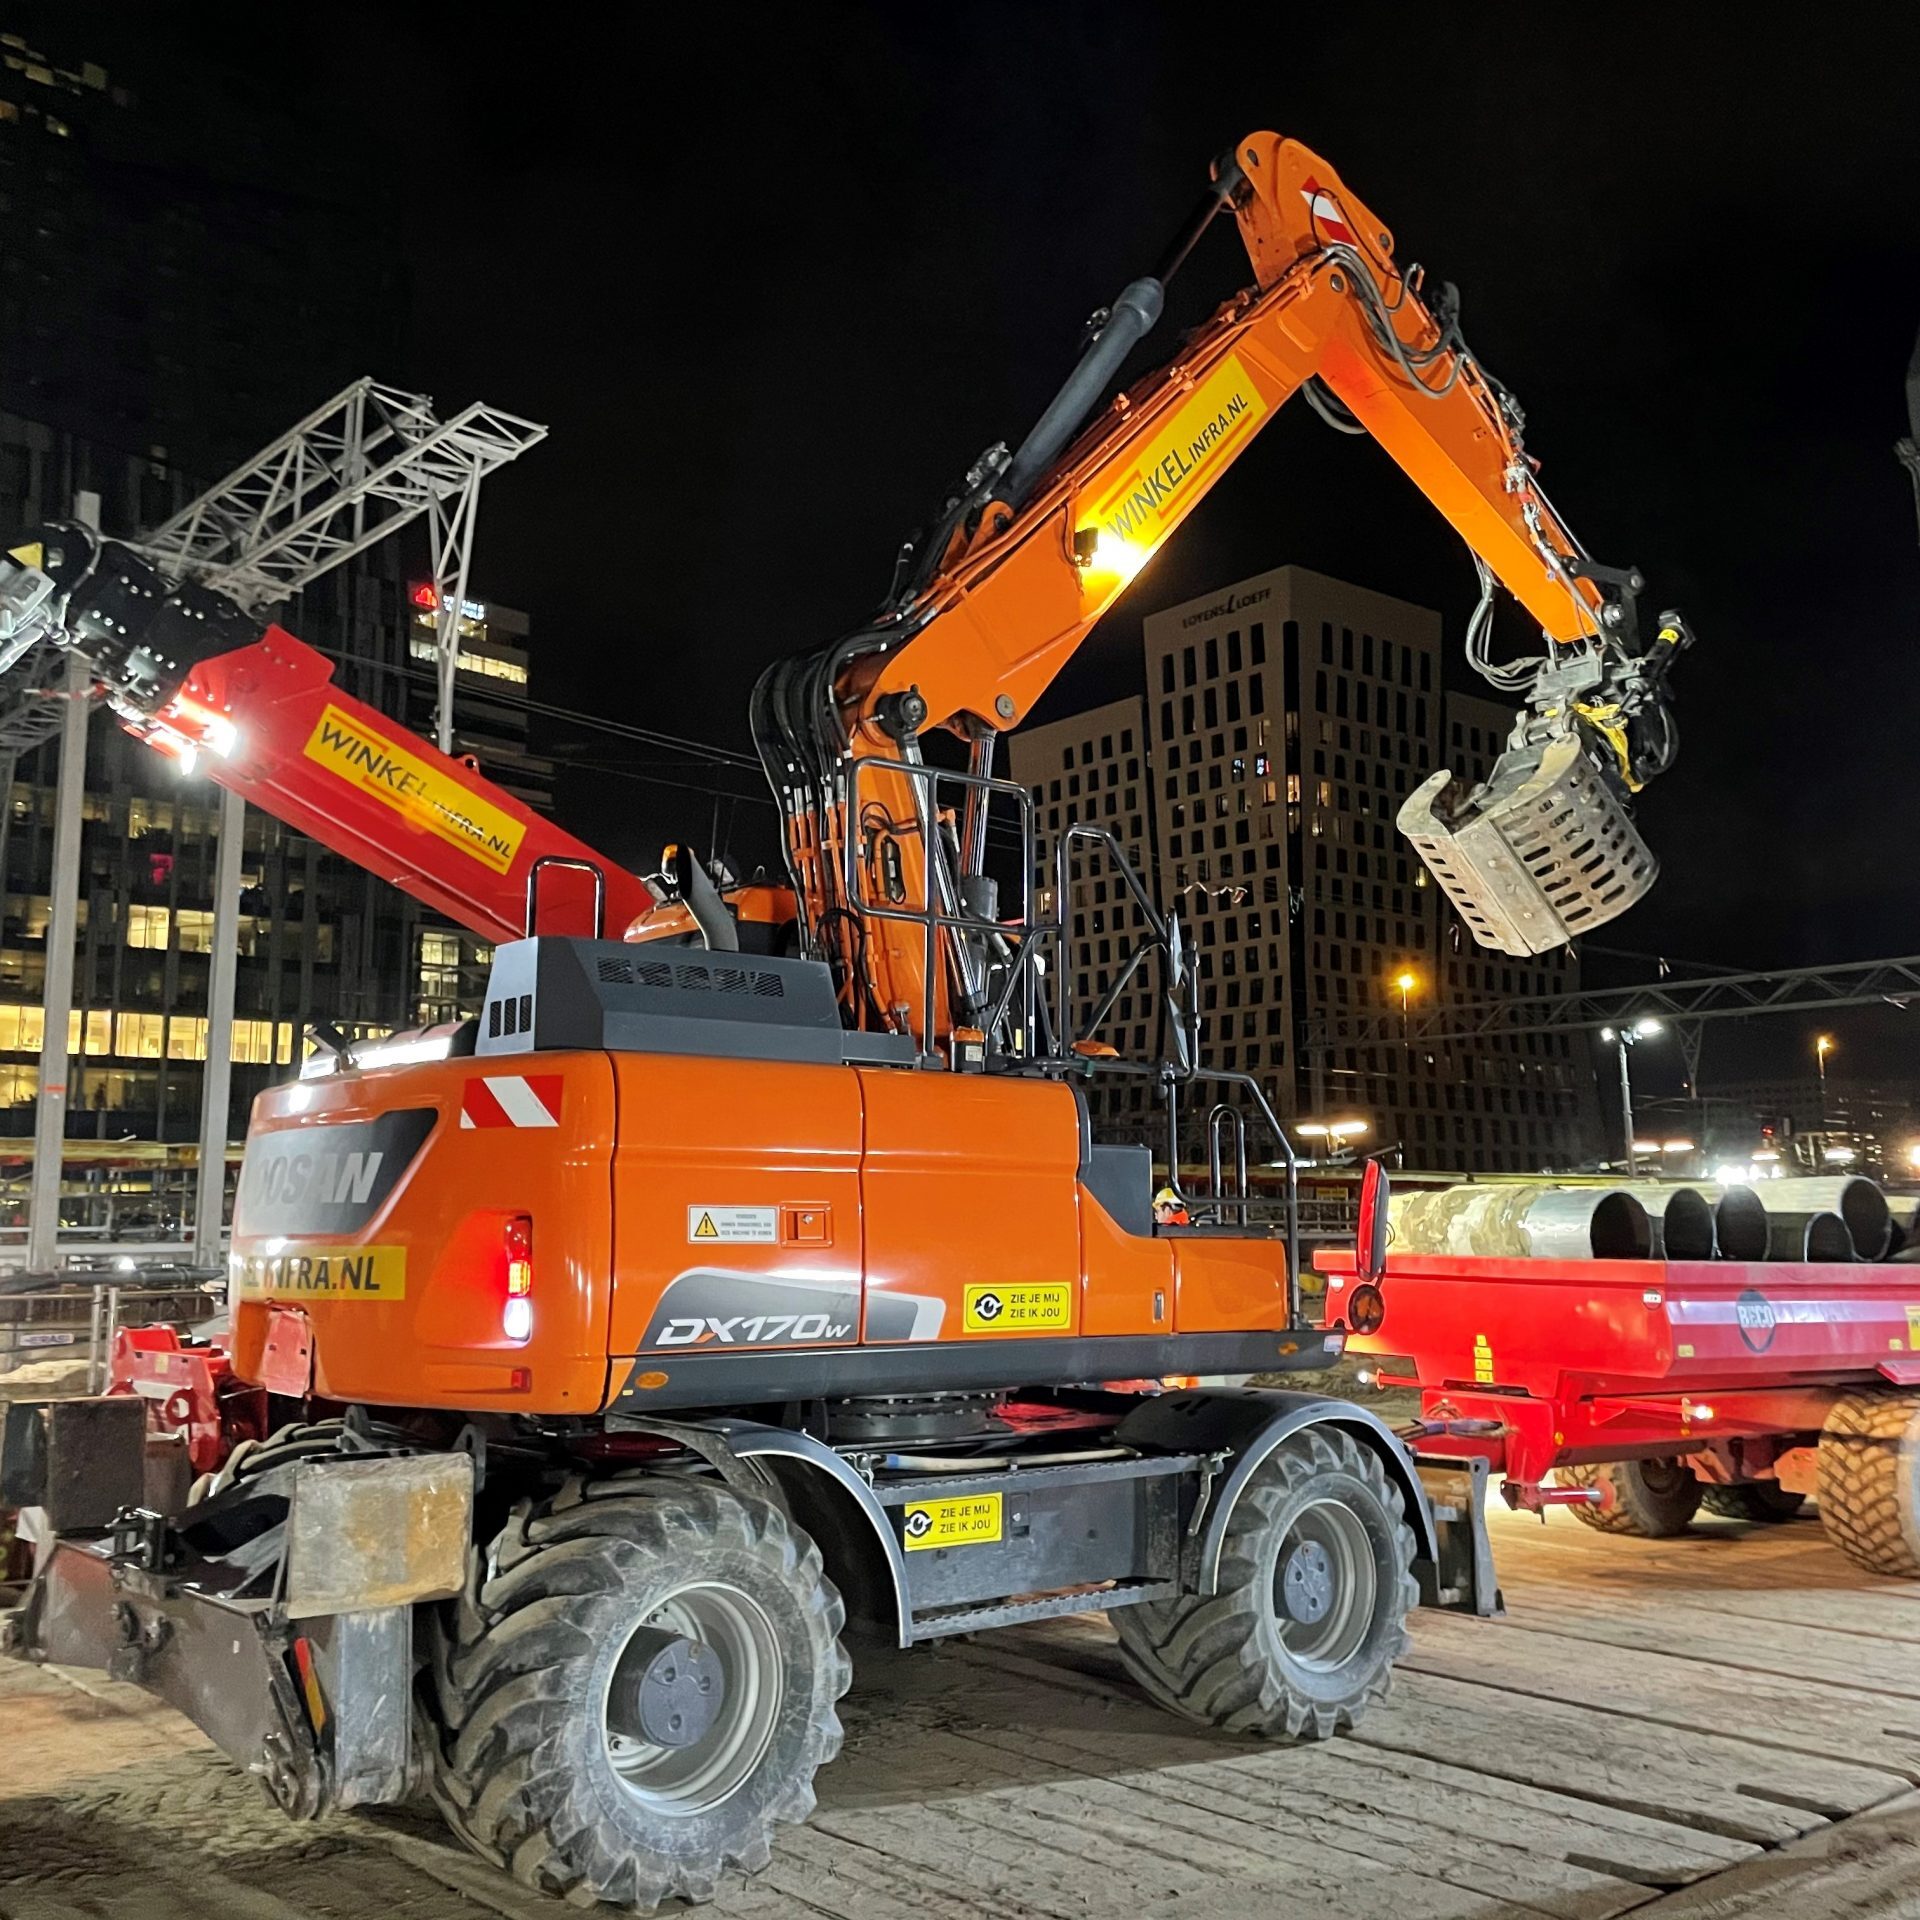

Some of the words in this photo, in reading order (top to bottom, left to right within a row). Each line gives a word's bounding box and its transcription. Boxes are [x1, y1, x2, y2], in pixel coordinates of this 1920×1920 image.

[1010, 1293, 1026, 1304] ZIE
[1029, 1293, 1041, 1303] JE
[1043, 1293, 1060, 1303] MIJ
[1010, 1308, 1026, 1318] ZIE
[1028, 1308, 1038, 1317] IK
[1041, 1307, 1060, 1317] JOU
[940, 1507, 956, 1518] ZIE
[958, 1506, 971, 1517] JE
[973, 1504, 991, 1515] MIJ
[939, 1523, 956, 1533] ZIE
[958, 1522, 969, 1531] IK
[971, 1520, 991, 1530] JOU
